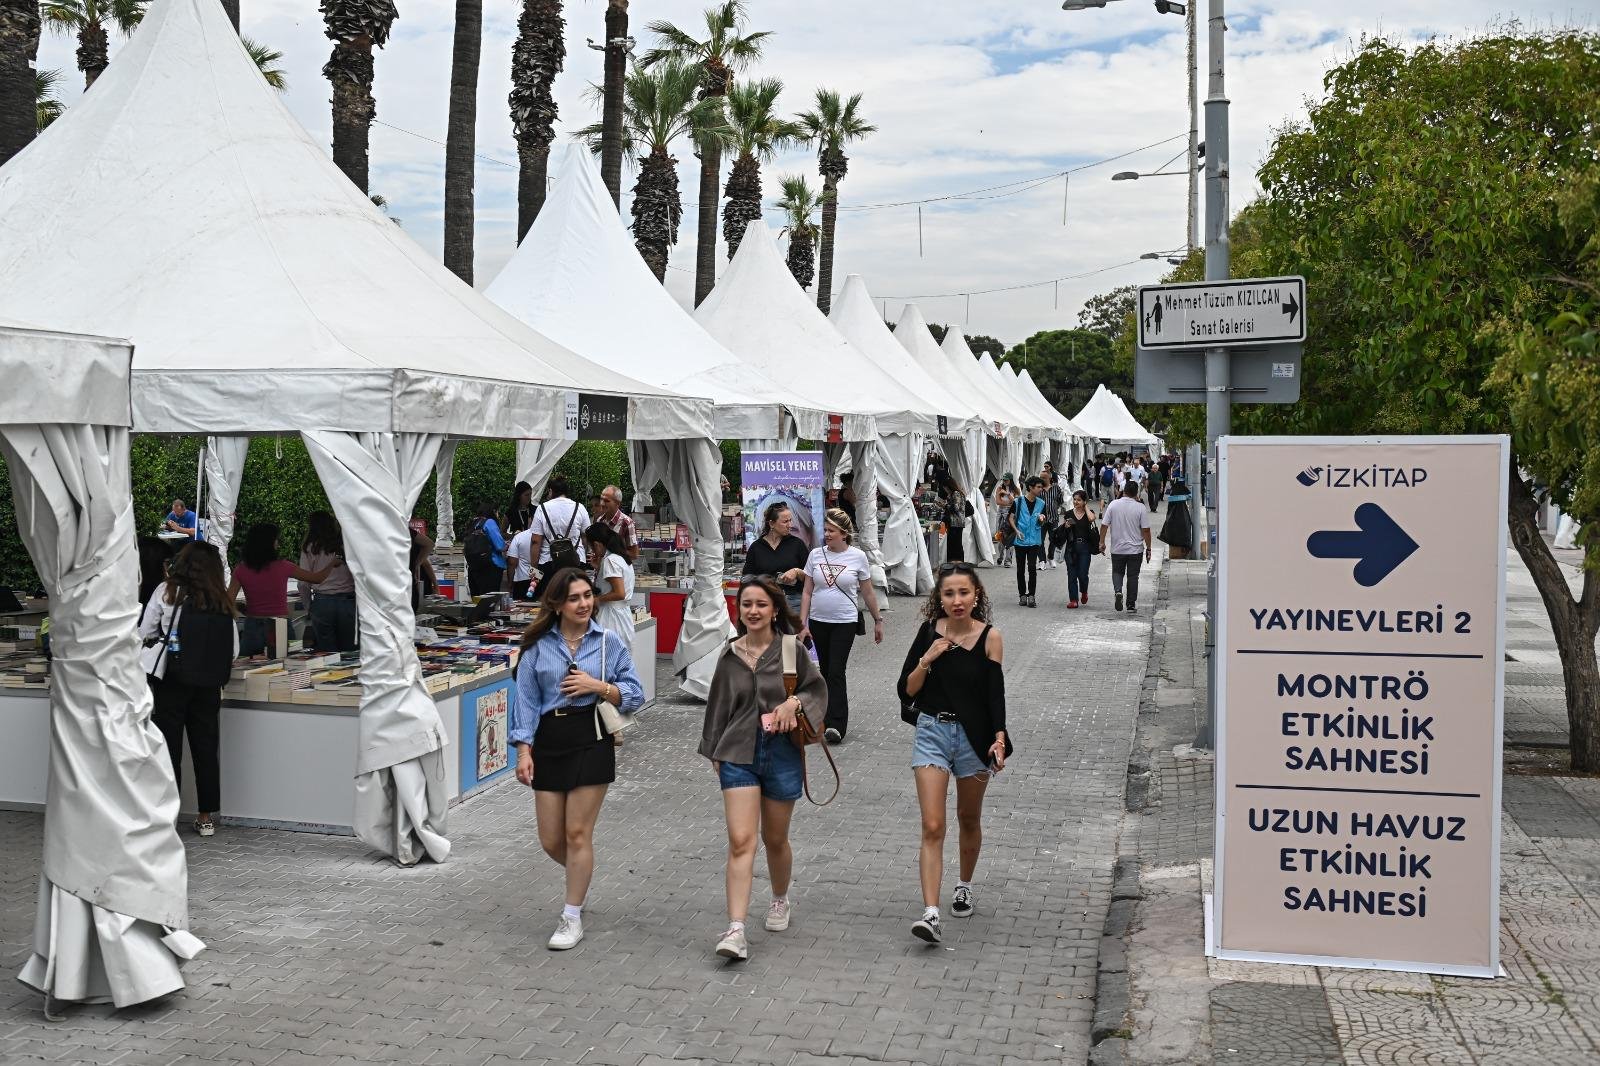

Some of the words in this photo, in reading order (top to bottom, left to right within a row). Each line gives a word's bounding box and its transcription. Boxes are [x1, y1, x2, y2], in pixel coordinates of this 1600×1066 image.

[1165, 294, 1202, 311] Mehmet
[1203, 292, 1235, 309] Tüzüm
[1237, 288, 1280, 307] KIZILCAN
[1190, 319, 1217, 336] Sanat
[1219, 317, 1254, 335] Galerisi
[566, 416, 578, 431] L19
[745, 458, 786, 472] MAVİSEL
[788, 460, 819, 472] YENER
[1326, 463, 1428, 488] İZKİTAP
[1249, 603, 1443, 634] YAYINEVLERİ
[1454, 611, 1471, 634] 2
[1277, 670, 1429, 701] MONTRÖ
[1281, 706, 1434, 741] ETKİNLİK
[1285, 743, 1428, 775] SAHNESİ
[1249, 807, 1338, 835] UZUN
[1351, 812, 1466, 841] HAVUZ
[1280, 843, 1432, 879] ETKİNLİK
[1283, 886, 1426, 918] SAHNESİ
